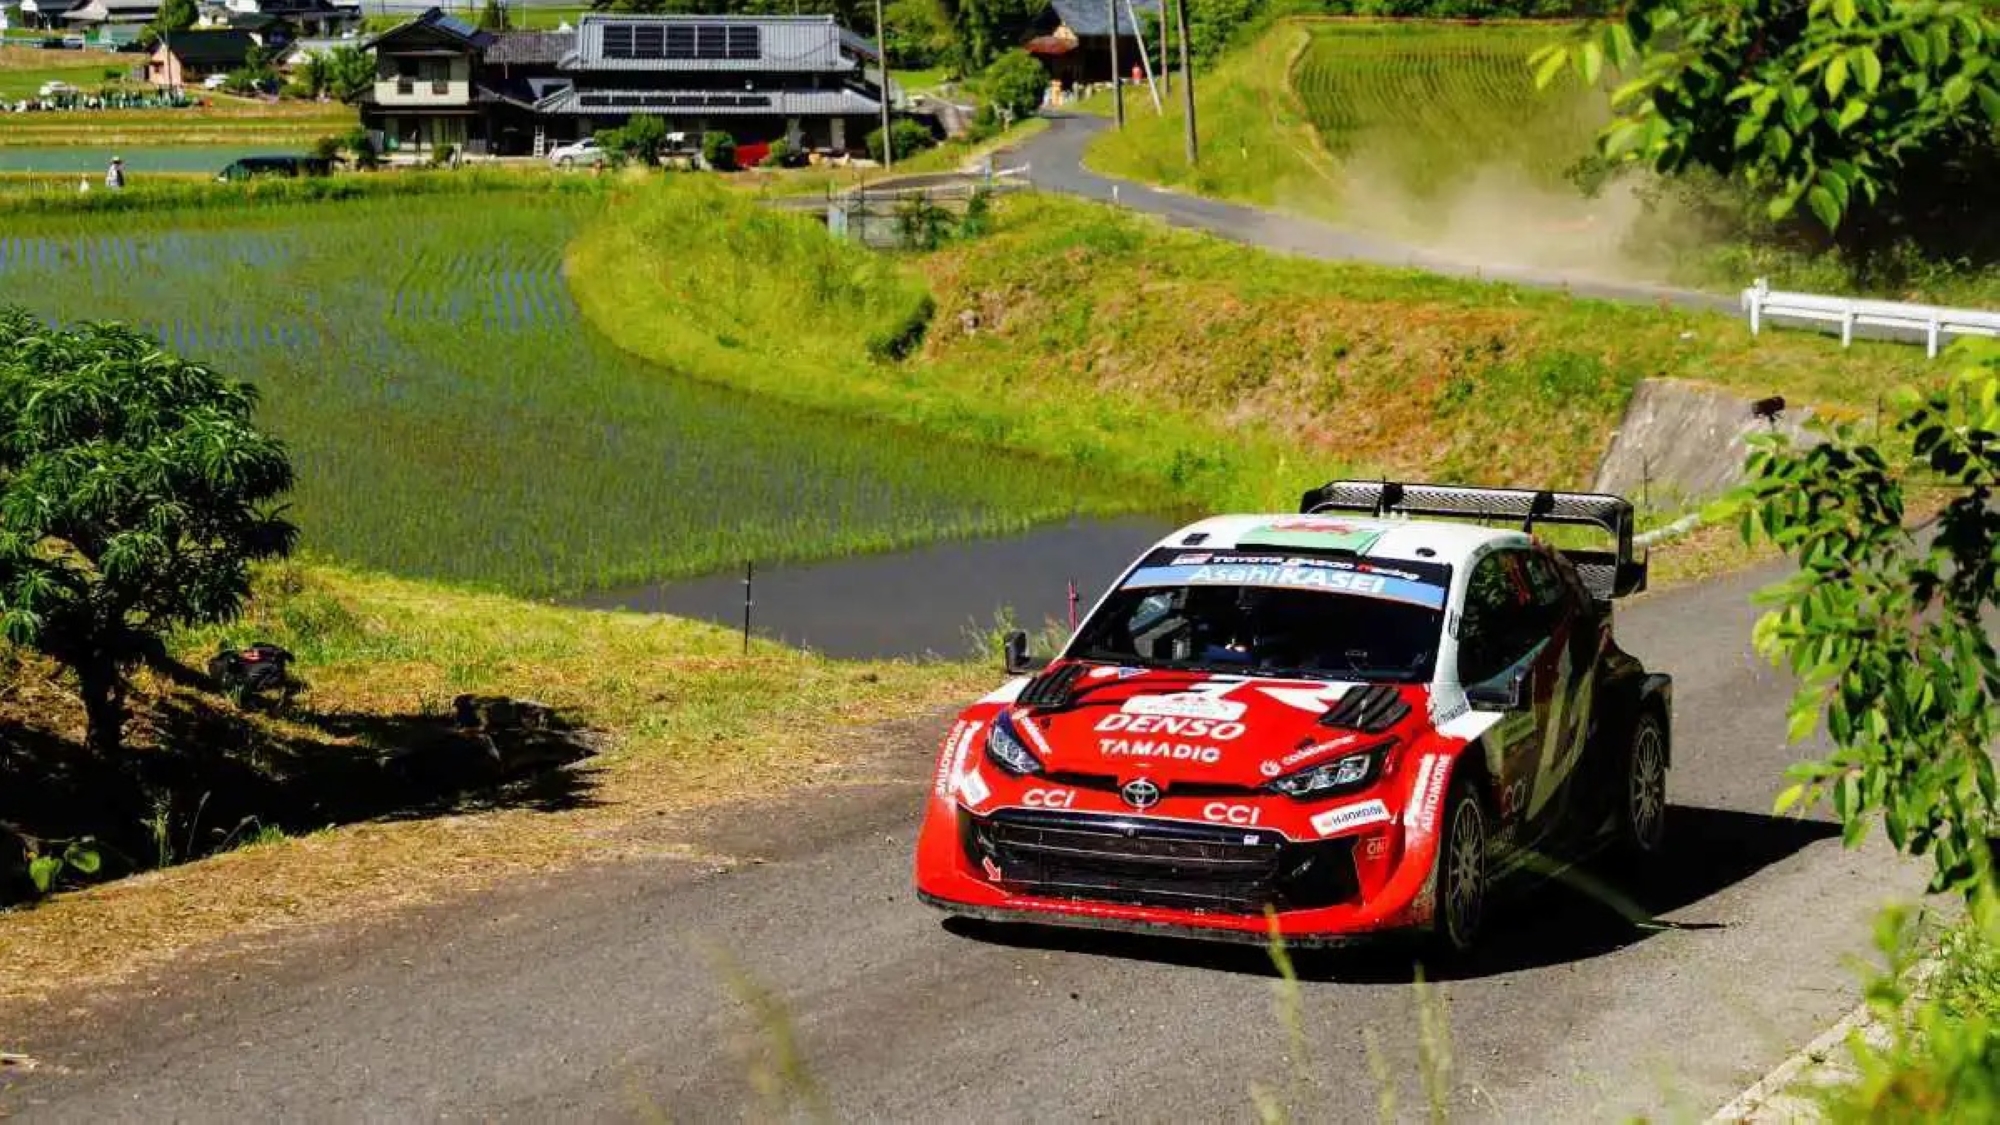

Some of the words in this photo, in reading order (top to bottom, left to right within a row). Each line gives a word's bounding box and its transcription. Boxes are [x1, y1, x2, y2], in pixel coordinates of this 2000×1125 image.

[1094, 714, 1246, 740] DENSO
[1021, 788, 1076, 808] CCI
[1203, 802, 1261, 825] CCI
